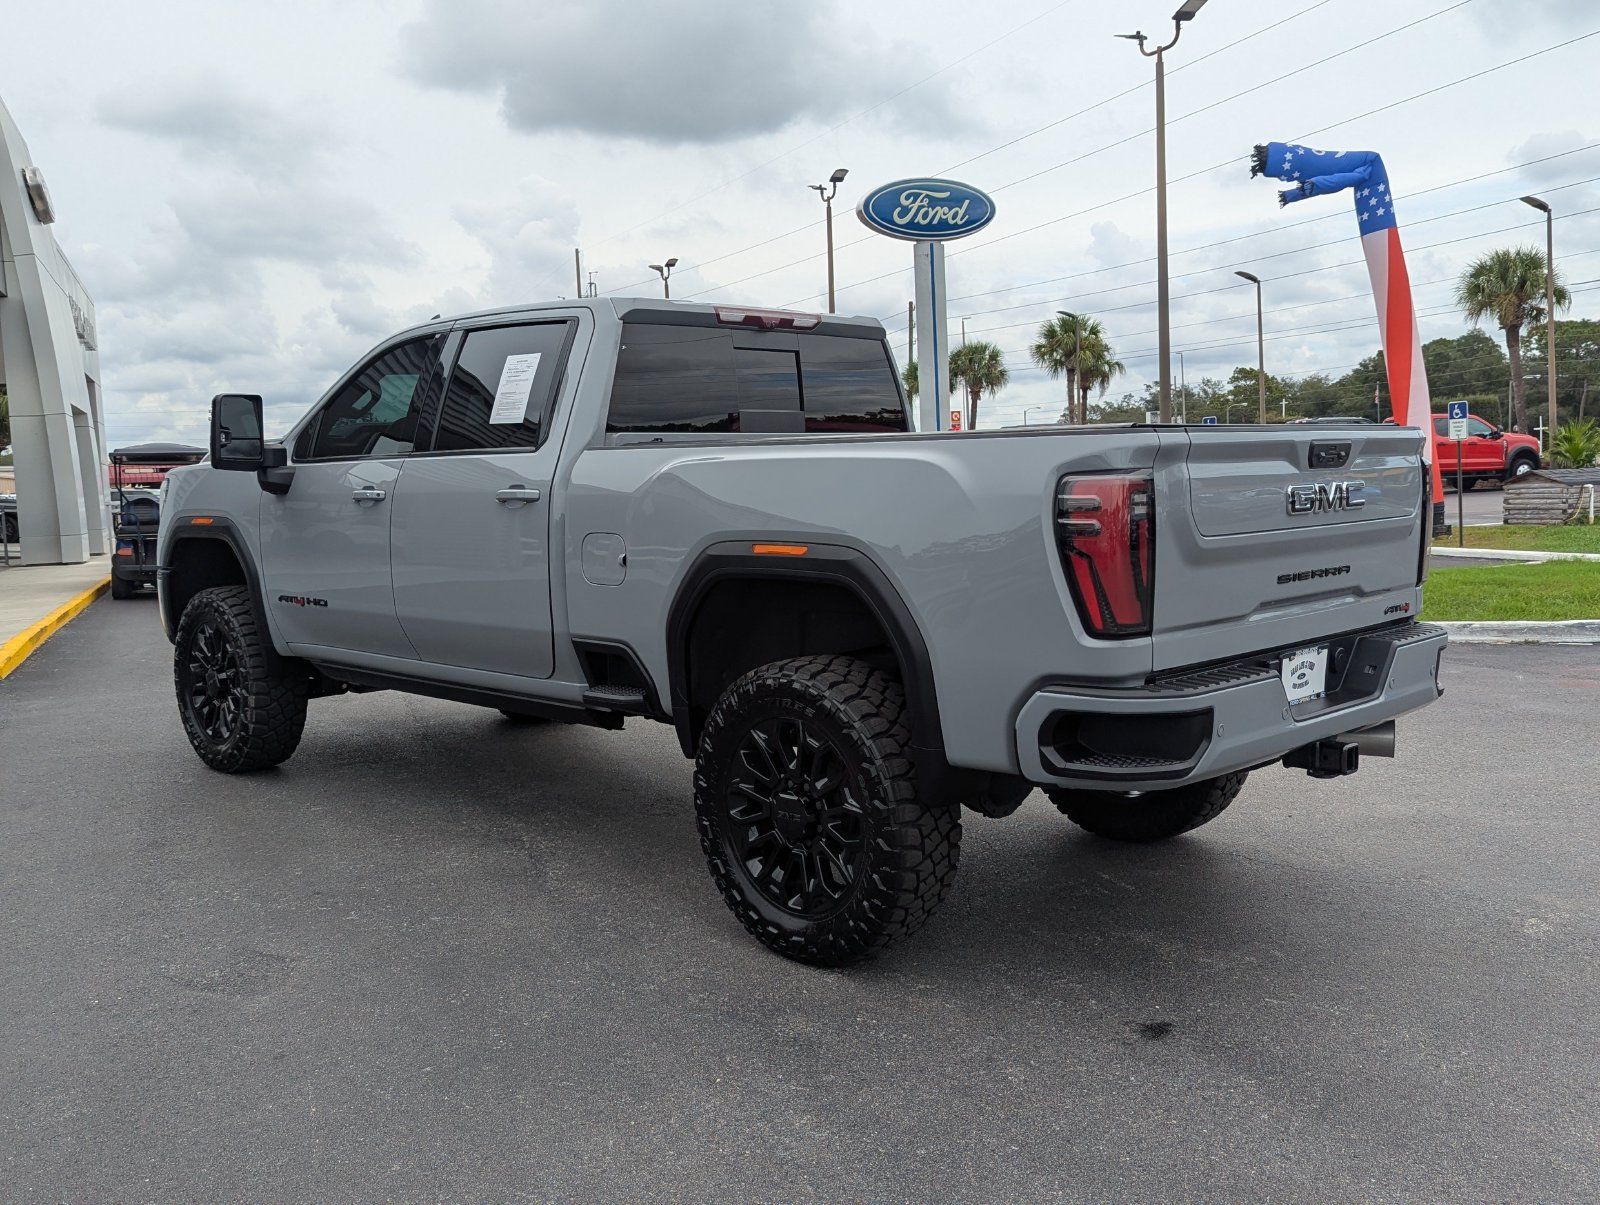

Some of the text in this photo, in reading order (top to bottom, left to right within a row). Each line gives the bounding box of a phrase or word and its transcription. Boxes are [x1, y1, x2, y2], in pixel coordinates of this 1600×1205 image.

[893, 189, 970, 225] Ford
[1286, 480, 1366, 516] GMC
[1277, 565, 1351, 584] SIERRA
[278, 595, 329, 608] AT4 HD
[1384, 602, 1410, 615] AT4
